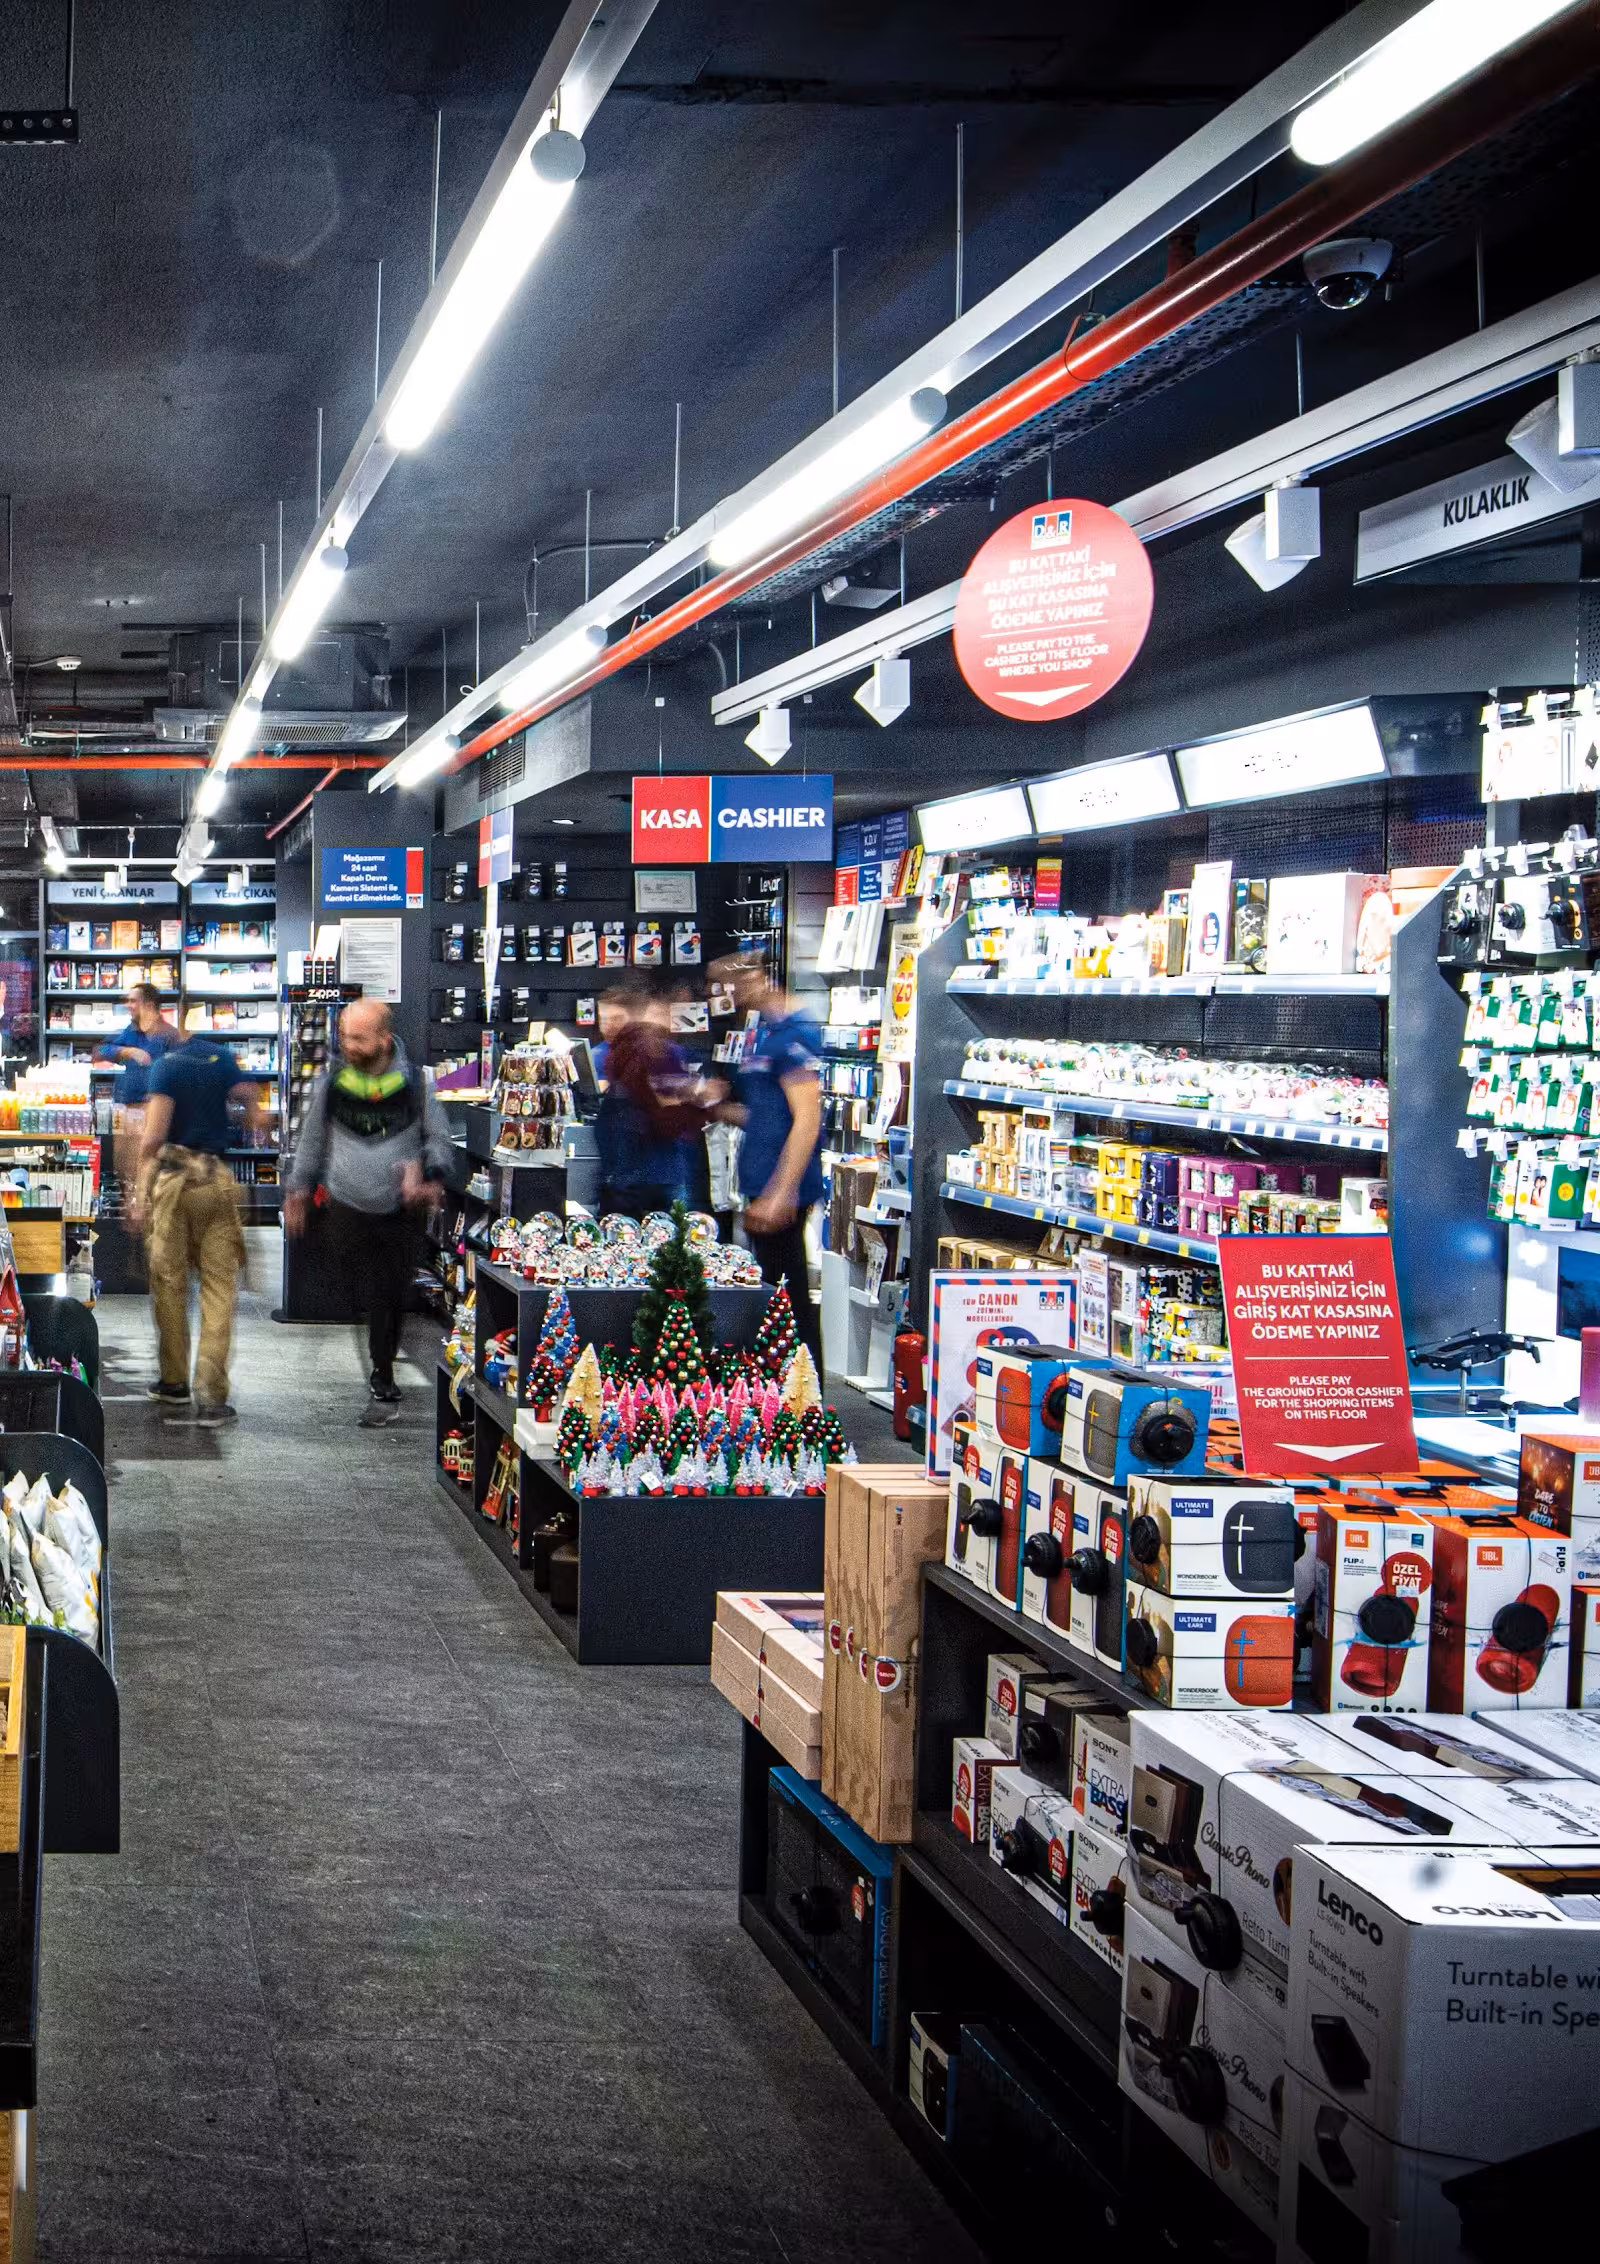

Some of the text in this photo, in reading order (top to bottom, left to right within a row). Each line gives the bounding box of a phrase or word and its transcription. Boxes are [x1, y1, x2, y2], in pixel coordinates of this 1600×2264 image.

[1443, 476, 1530, 527] KULAKLIK
[1034, 520, 1070, 539] D&R
[1009, 545, 1091, 574] BU KATTAKİ
[983, 560, 1117, 596] ALIŞVERİŞİNİZ İÇİN
[988, 583, 1109, 612] BU KAT KASASINA
[992, 602, 1103, 629] ÖDEME YAPINIZ
[997, 633, 1096, 654] PLEASE PAY TO THE
[984, 644, 1109, 667] CASHIER ON THE FLOOR
[999, 657, 1092, 677] WHERE YOU SHOP
[640, 807, 825, 829] KASA CASHIER
[351, 864, 378, 872] 24 saat
[330, 884, 359, 892] Kamera
[360, 883, 388, 892] Sistemi
[365, 874, 388, 882] Devre
[760, 877, 781, 893] Lexar
[72, 887, 97, 898] YENİ
[325, 894, 353, 902] Kontrol
[1262, 1260, 1354, 1278] BU KATTAKİ
[979, 1293, 1018, 1306] CANON
[1235, 1280, 1386, 1301] ALIŞVERİŞİNİZ İÇİN
[1234, 1301, 1394, 1321] GİRİŞ KAT KASASINA
[1251, 1322, 1380, 1339] ÖDEME YAPINIZ
[1289, 1376, 1351, 1386] PLEASE PAY
[1243, 1386, 1404, 1397] THE GROUND FLOOR CASHIER
[1255, 1398, 1394, 1409] FOR THE SHOPPING ITEMS
[1284, 1410, 1367, 1419] ON THIS FLOOR
[1538, 1503, 1548, 1514] TO
[1303, 1517, 1317, 1526] JBL
[1350, 1534, 1365, 1543] JBL
[1482, 1551, 1499, 1561] JBL
[1393, 1562, 1422, 1576] ÖZEL
[1392, 1574, 1421, 1588] FİYAT
[1092, 1738, 1118, 1757] SONY
[1091, 1768, 1125, 1798] EXTRA
[1090, 1786, 1126, 1818] BASS
[1079, 1832, 1100, 1854] SONY
[1076, 1881, 1093, 1910] BA
[1318, 1878, 1383, 1947] Lenco
[1432, 1905, 1563, 1922] Lenco
[1241, 1911, 1266, 1942] Retro
[1308, 1929, 1368, 1988] Turntable with
[1308, 1950, 1380, 2019] Built-in Speakers
[1447, 1961, 1568, 1989] Turntable
[1447, 1999, 1600, 2036] Built-in Spe
